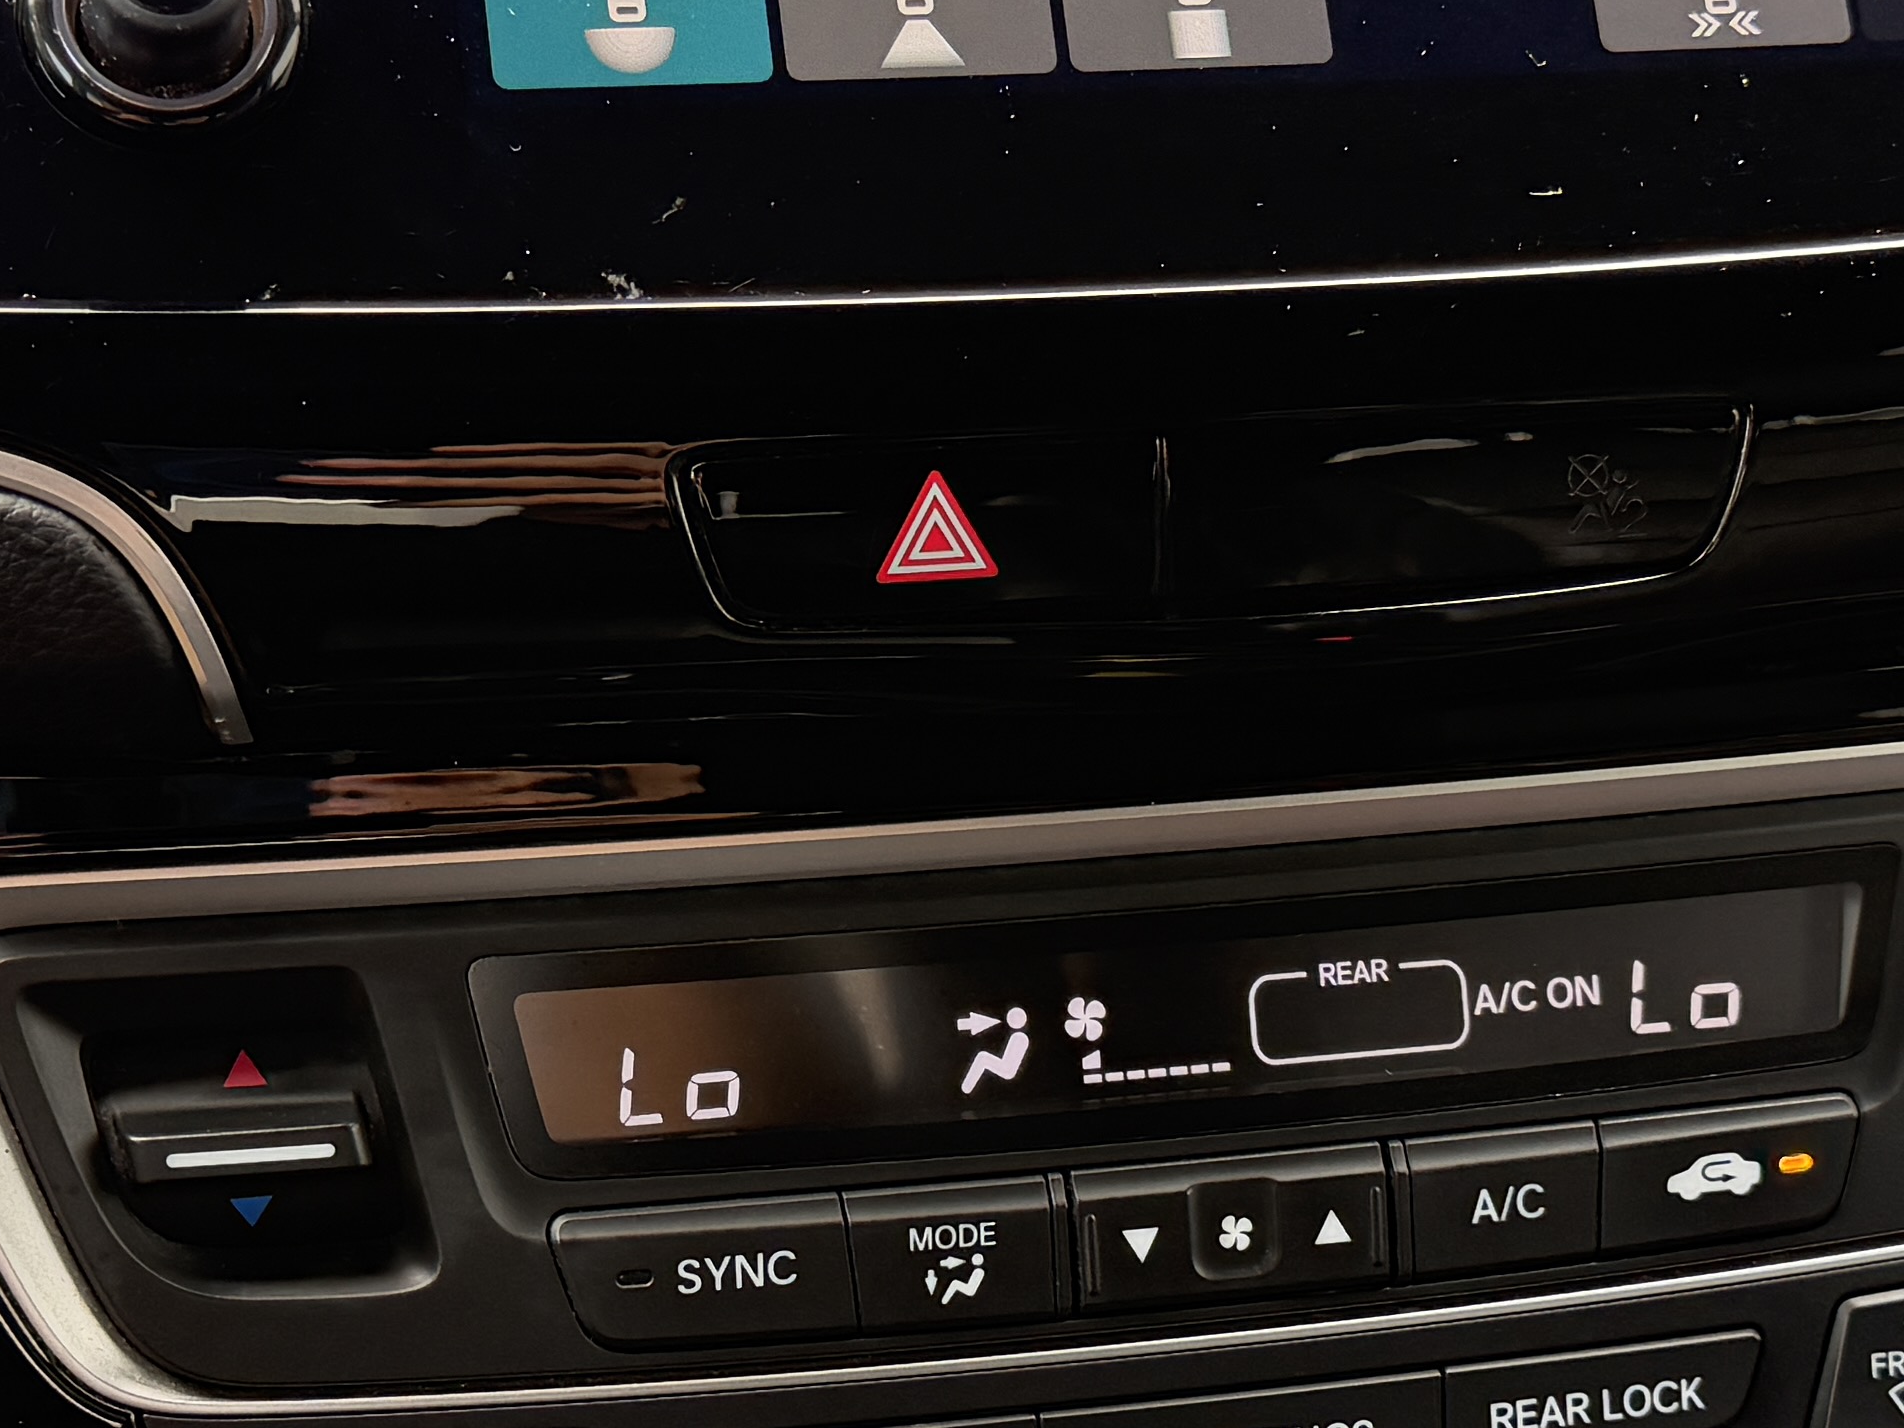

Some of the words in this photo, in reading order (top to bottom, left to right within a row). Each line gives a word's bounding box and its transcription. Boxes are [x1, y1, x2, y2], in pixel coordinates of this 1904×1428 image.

[1316, 959, 1391, 988] REAR
[1472, 978, 1539, 1017] A/C
[1545, 973, 1602, 1010] ON
[1629, 958, 1743, 1036] Lo
[618, 1046, 741, 1128] Lo
[1470, 1182, 1546, 1226] A/C
[907, 1220, 998, 1253] MODE
[676, 1249, 799, 1296] SYNC
[1601, 1375, 1706, 1422] LOCK
